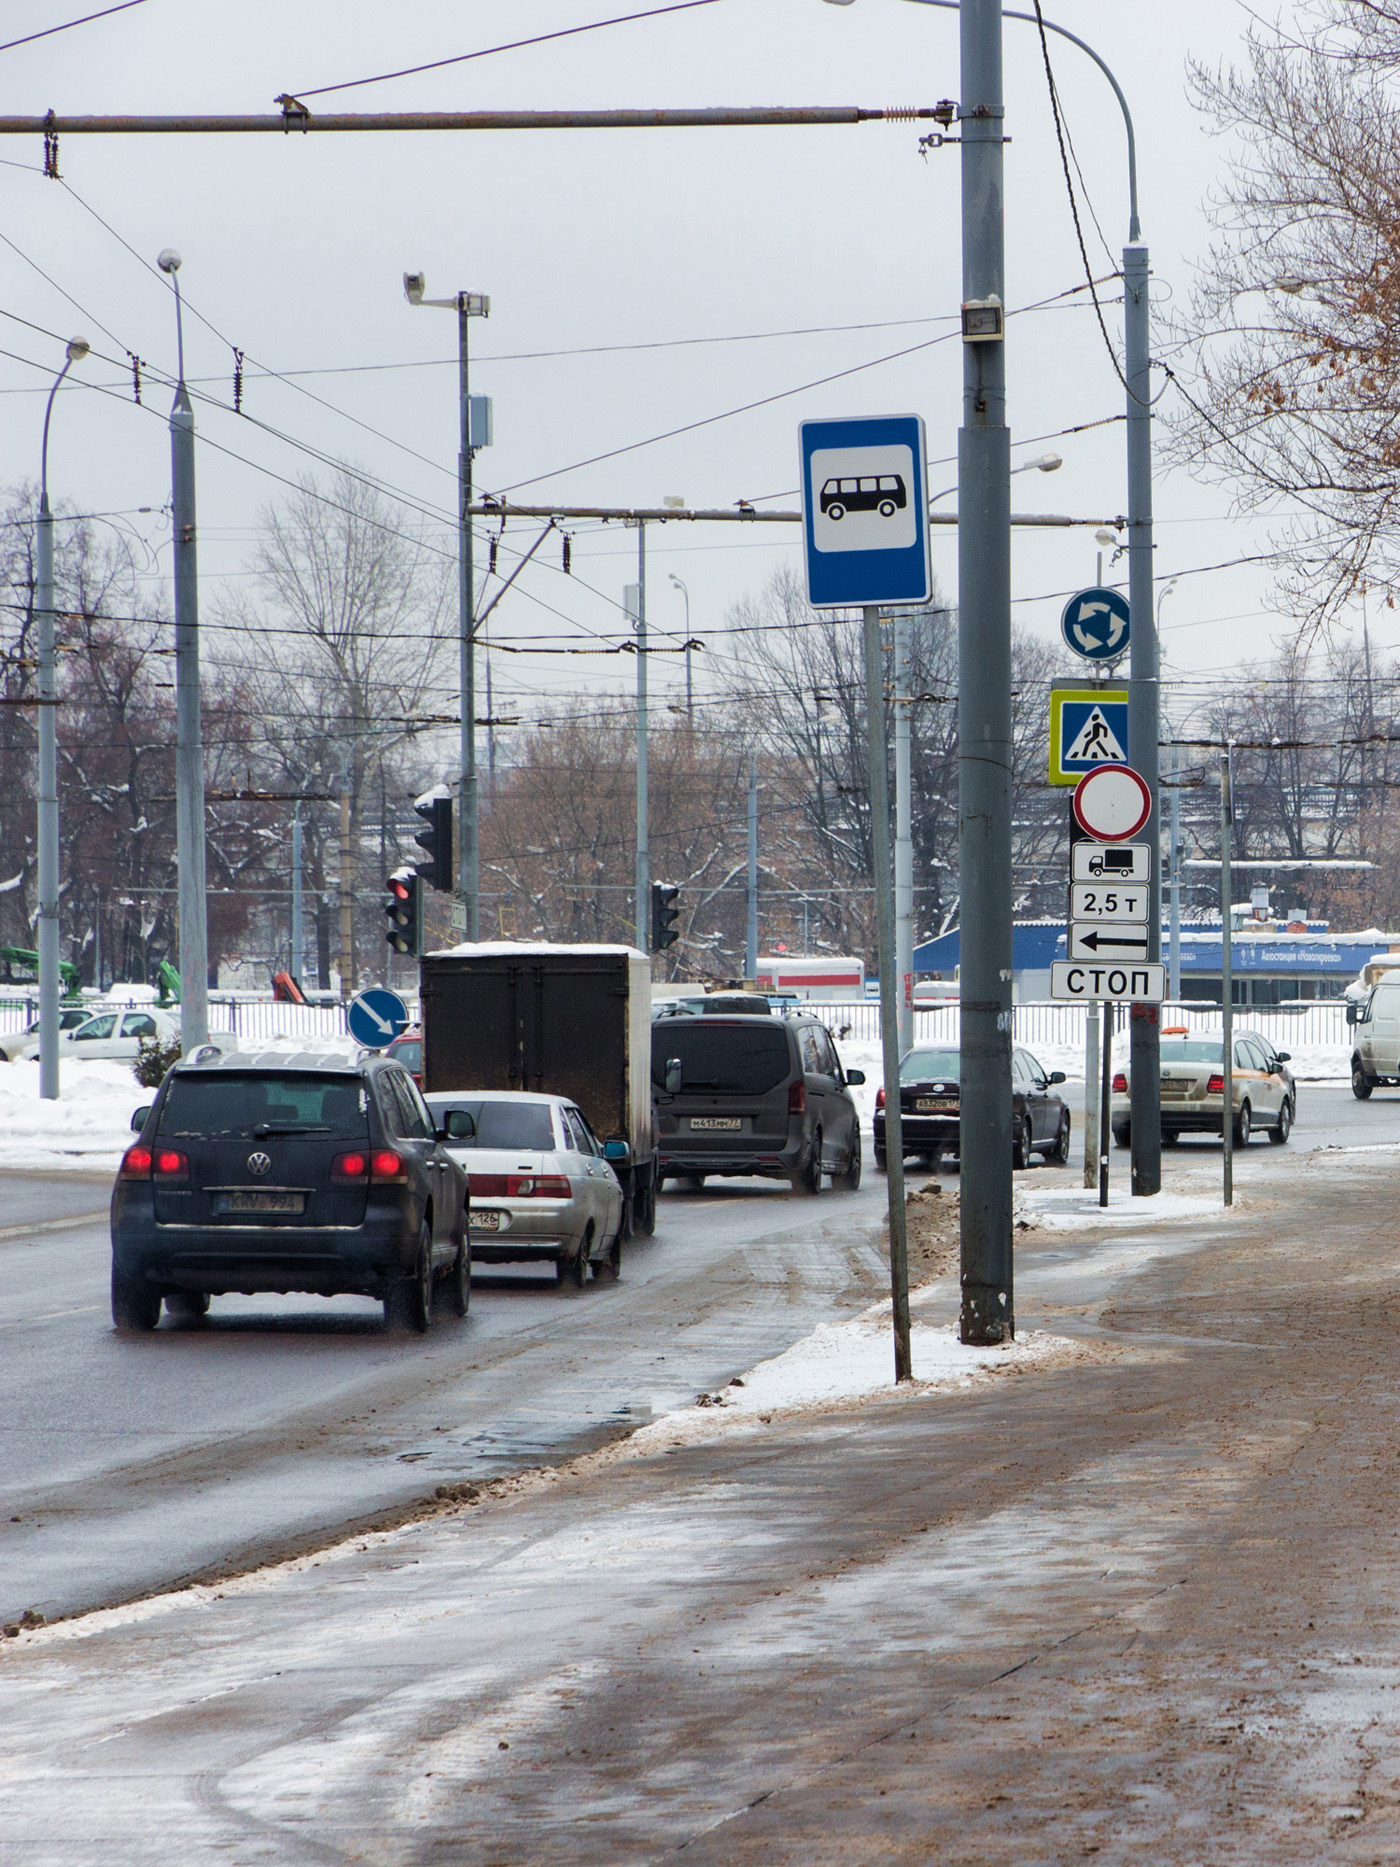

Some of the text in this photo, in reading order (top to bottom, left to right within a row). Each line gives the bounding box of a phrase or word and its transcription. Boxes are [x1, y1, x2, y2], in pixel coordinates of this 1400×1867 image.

[1083, 893, 1118, 916] 2,5
[1261, 949, 1297, 963] Автостанция
[1066, 968, 1150, 996] СТОП
[478, 1213, 498, 1223] 126
